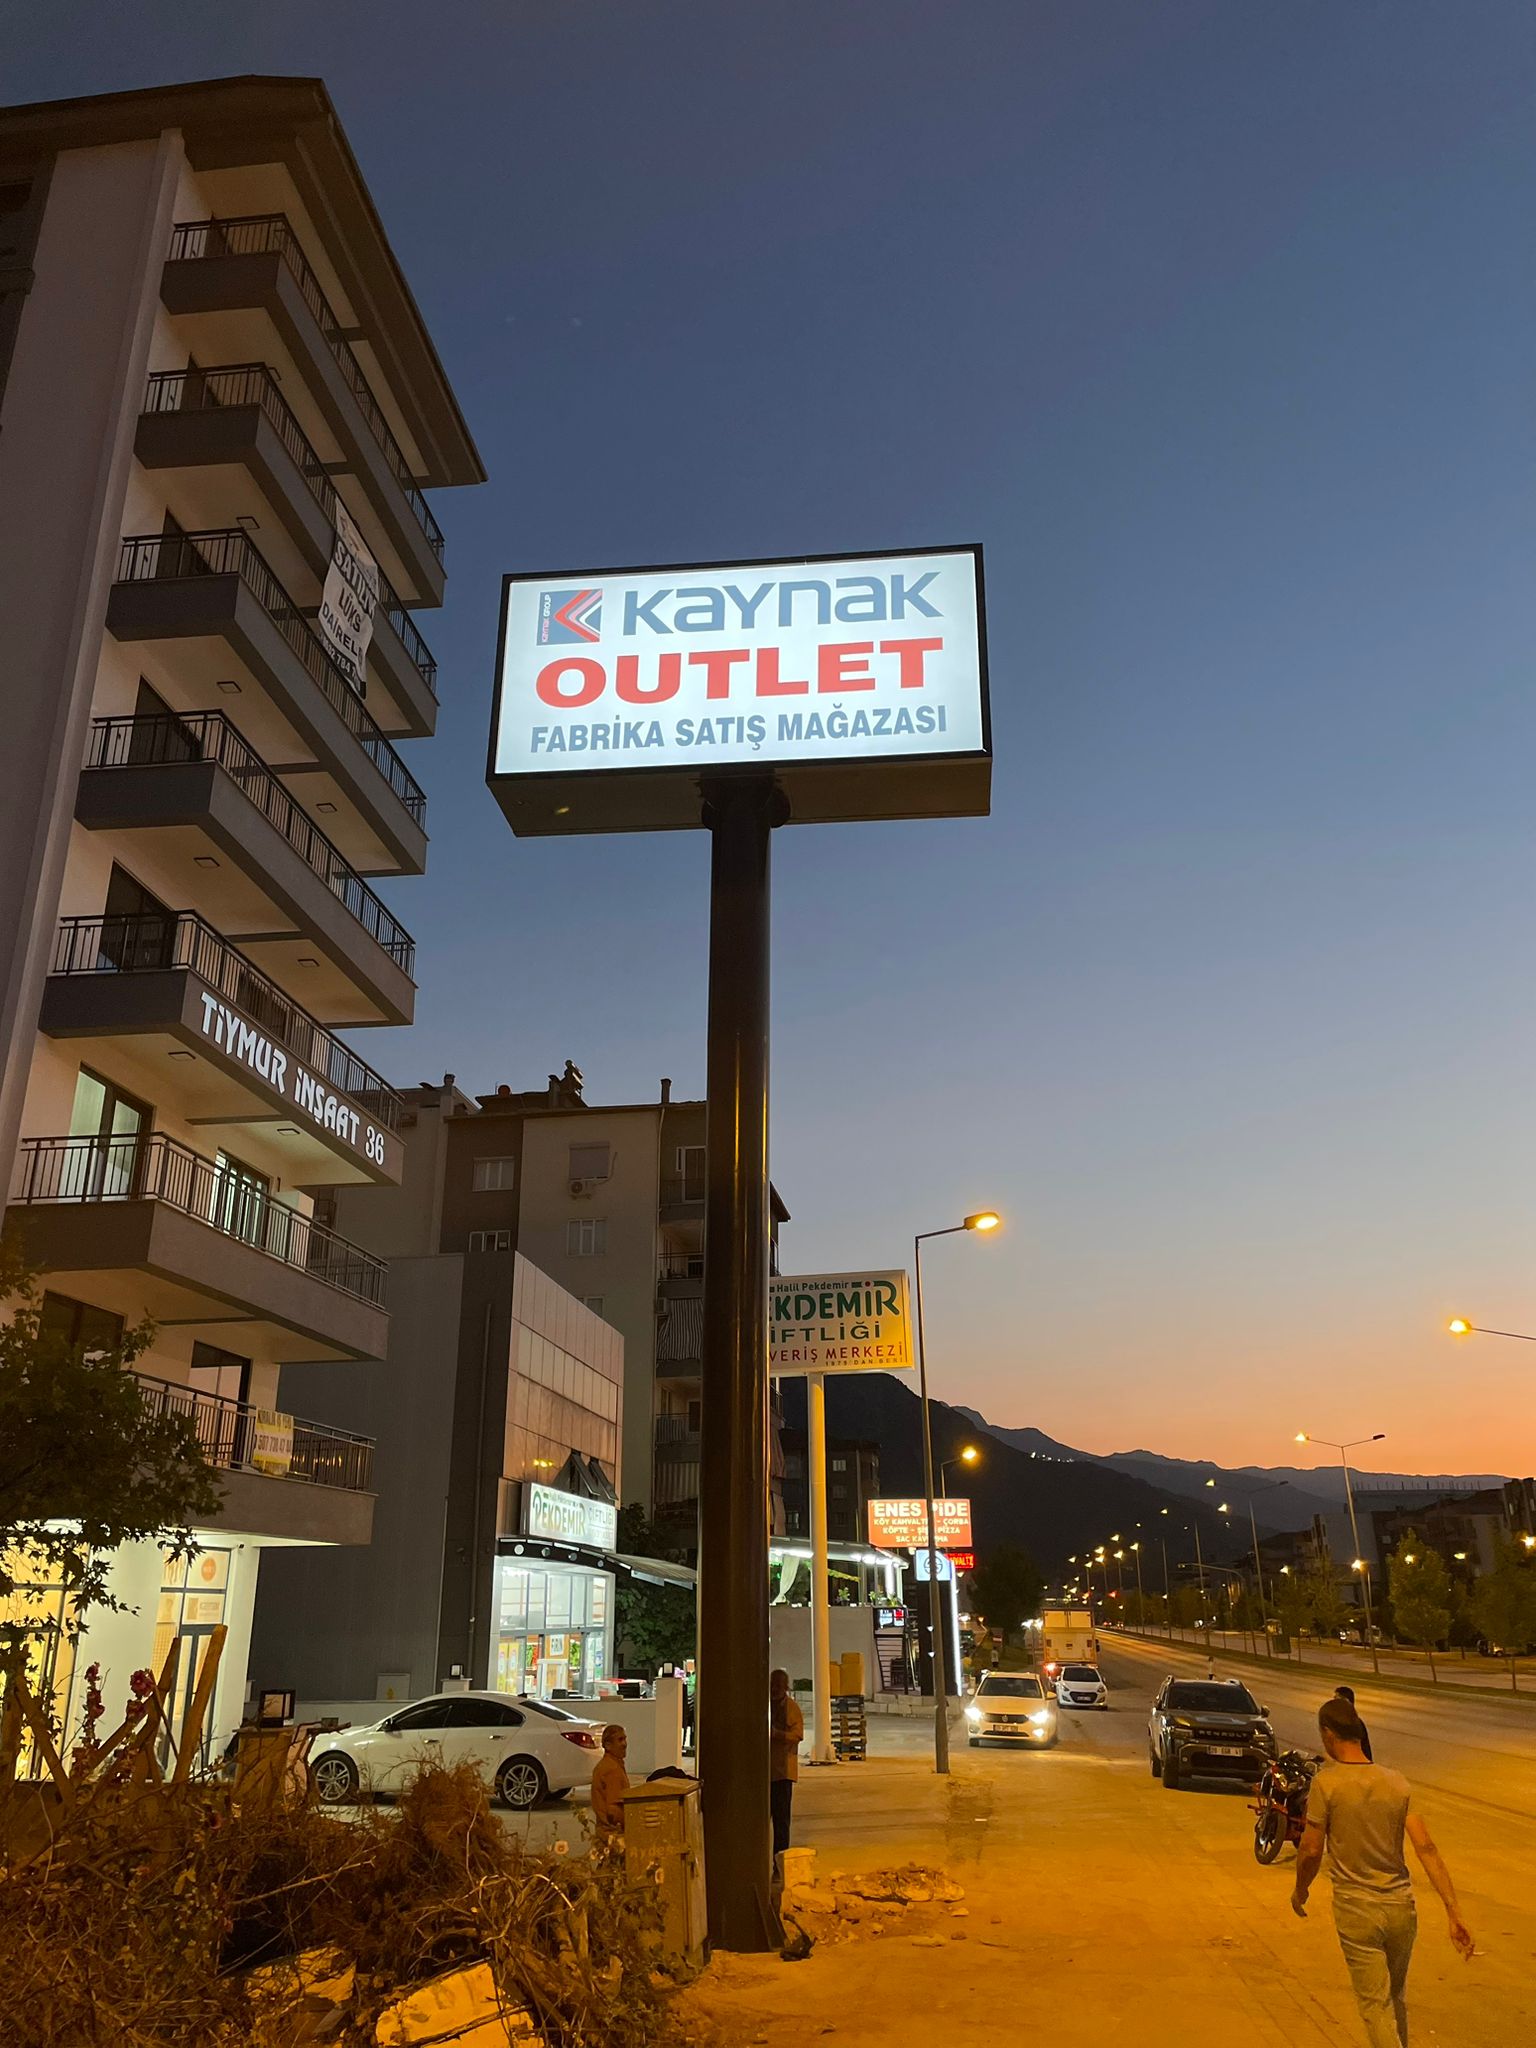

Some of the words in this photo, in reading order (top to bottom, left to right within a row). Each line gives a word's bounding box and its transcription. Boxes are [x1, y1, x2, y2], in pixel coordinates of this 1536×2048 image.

[339, 588, 361, 632] LÜKS
[536, 637, 943, 708] OUTLET
[531, 714, 665, 753] FABRİKA
[675, 714, 767, 751] SATIŞ
[777, 702, 947, 742] MAĞAZASI
[201, 991, 288, 1094] TİYMUR
[294, 1066, 360, 1146] İNŞAAT
[365, 1125, 385, 1166] 36
[776, 1282, 800, 1293] Halil
[802, 1281, 849, 1291] Pekdemir
[769, 1280, 900, 1321] KDEMİR
[770, 1321, 880, 1343] İFTLİĞİ
[769, 1346, 818, 1363] VERİŞ
[825, 1341, 903, 1360] MERKEZİ
[533, 1490, 586, 1536] PEKDEMİR
[874, 1502, 922, 1517] ENES
[874, 1517, 889, 1525] KÖY
[943, 1517, 969, 1527] ÇORBA
[883, 1525, 908, 1534] KÖFTE
[1199, 1730, 1247, 1738] RENAULT
